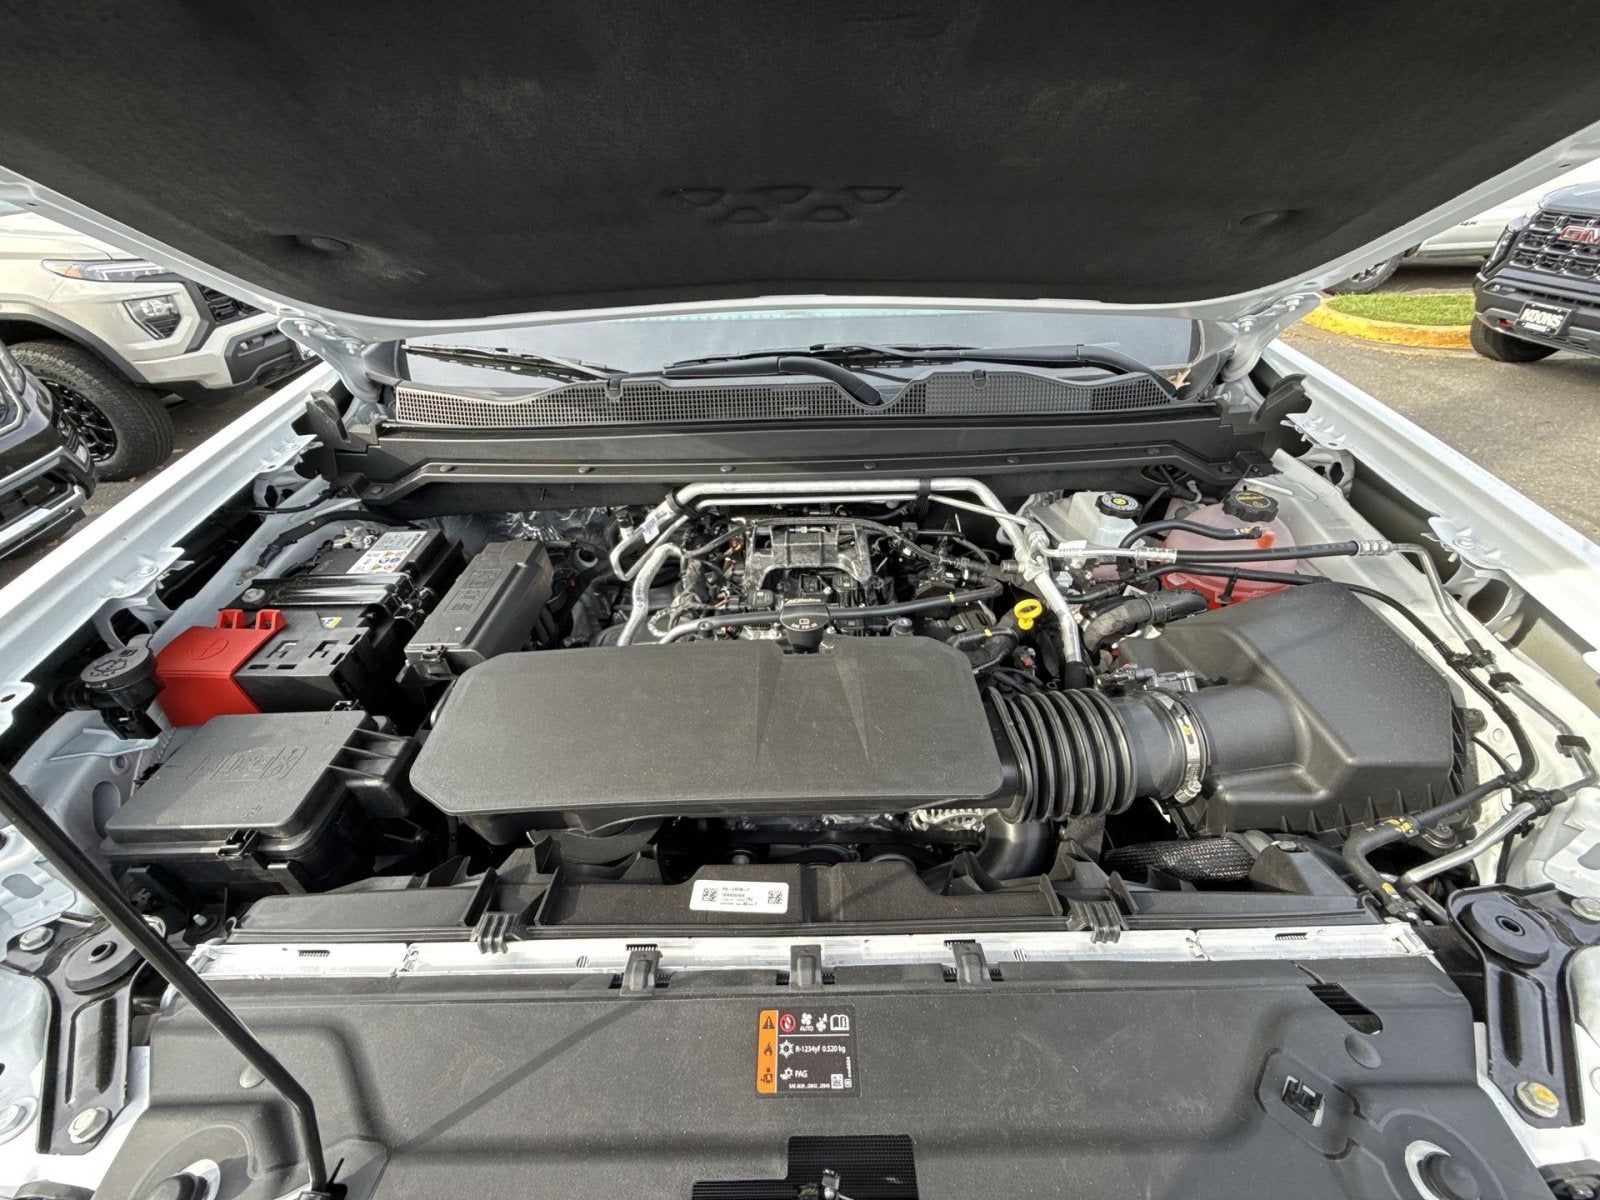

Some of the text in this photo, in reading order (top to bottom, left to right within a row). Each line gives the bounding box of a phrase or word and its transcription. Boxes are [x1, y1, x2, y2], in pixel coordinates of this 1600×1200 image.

[1520, 308, 1564, 329] KOONS
[795, 1044, 846, 1054] R-1234yf 0.520 kg
[794, 1069, 808, 1078] PAG
